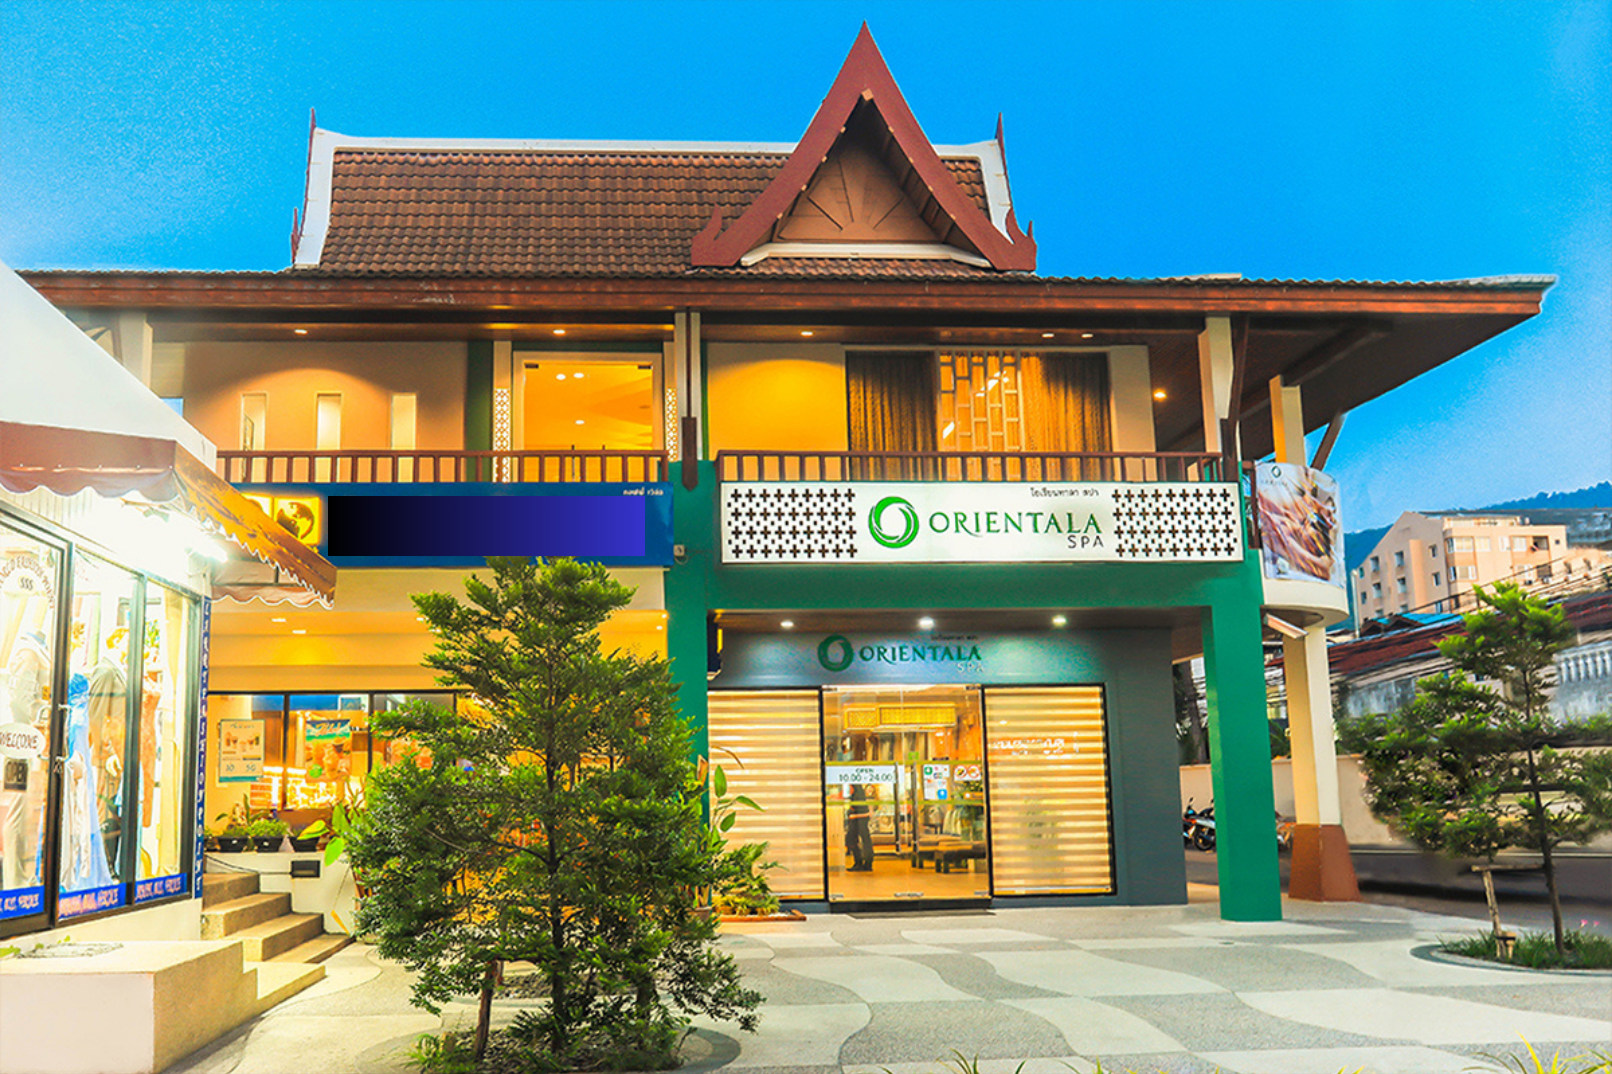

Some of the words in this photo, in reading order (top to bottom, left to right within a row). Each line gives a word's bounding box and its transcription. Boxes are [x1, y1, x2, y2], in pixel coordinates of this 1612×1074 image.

[929, 511, 1103, 537] ORIENTALA
[1067, 535, 1104, 549] SPA
[859, 645, 982, 665] ORIENTALA
[957, 660, 985, 673] SPA
